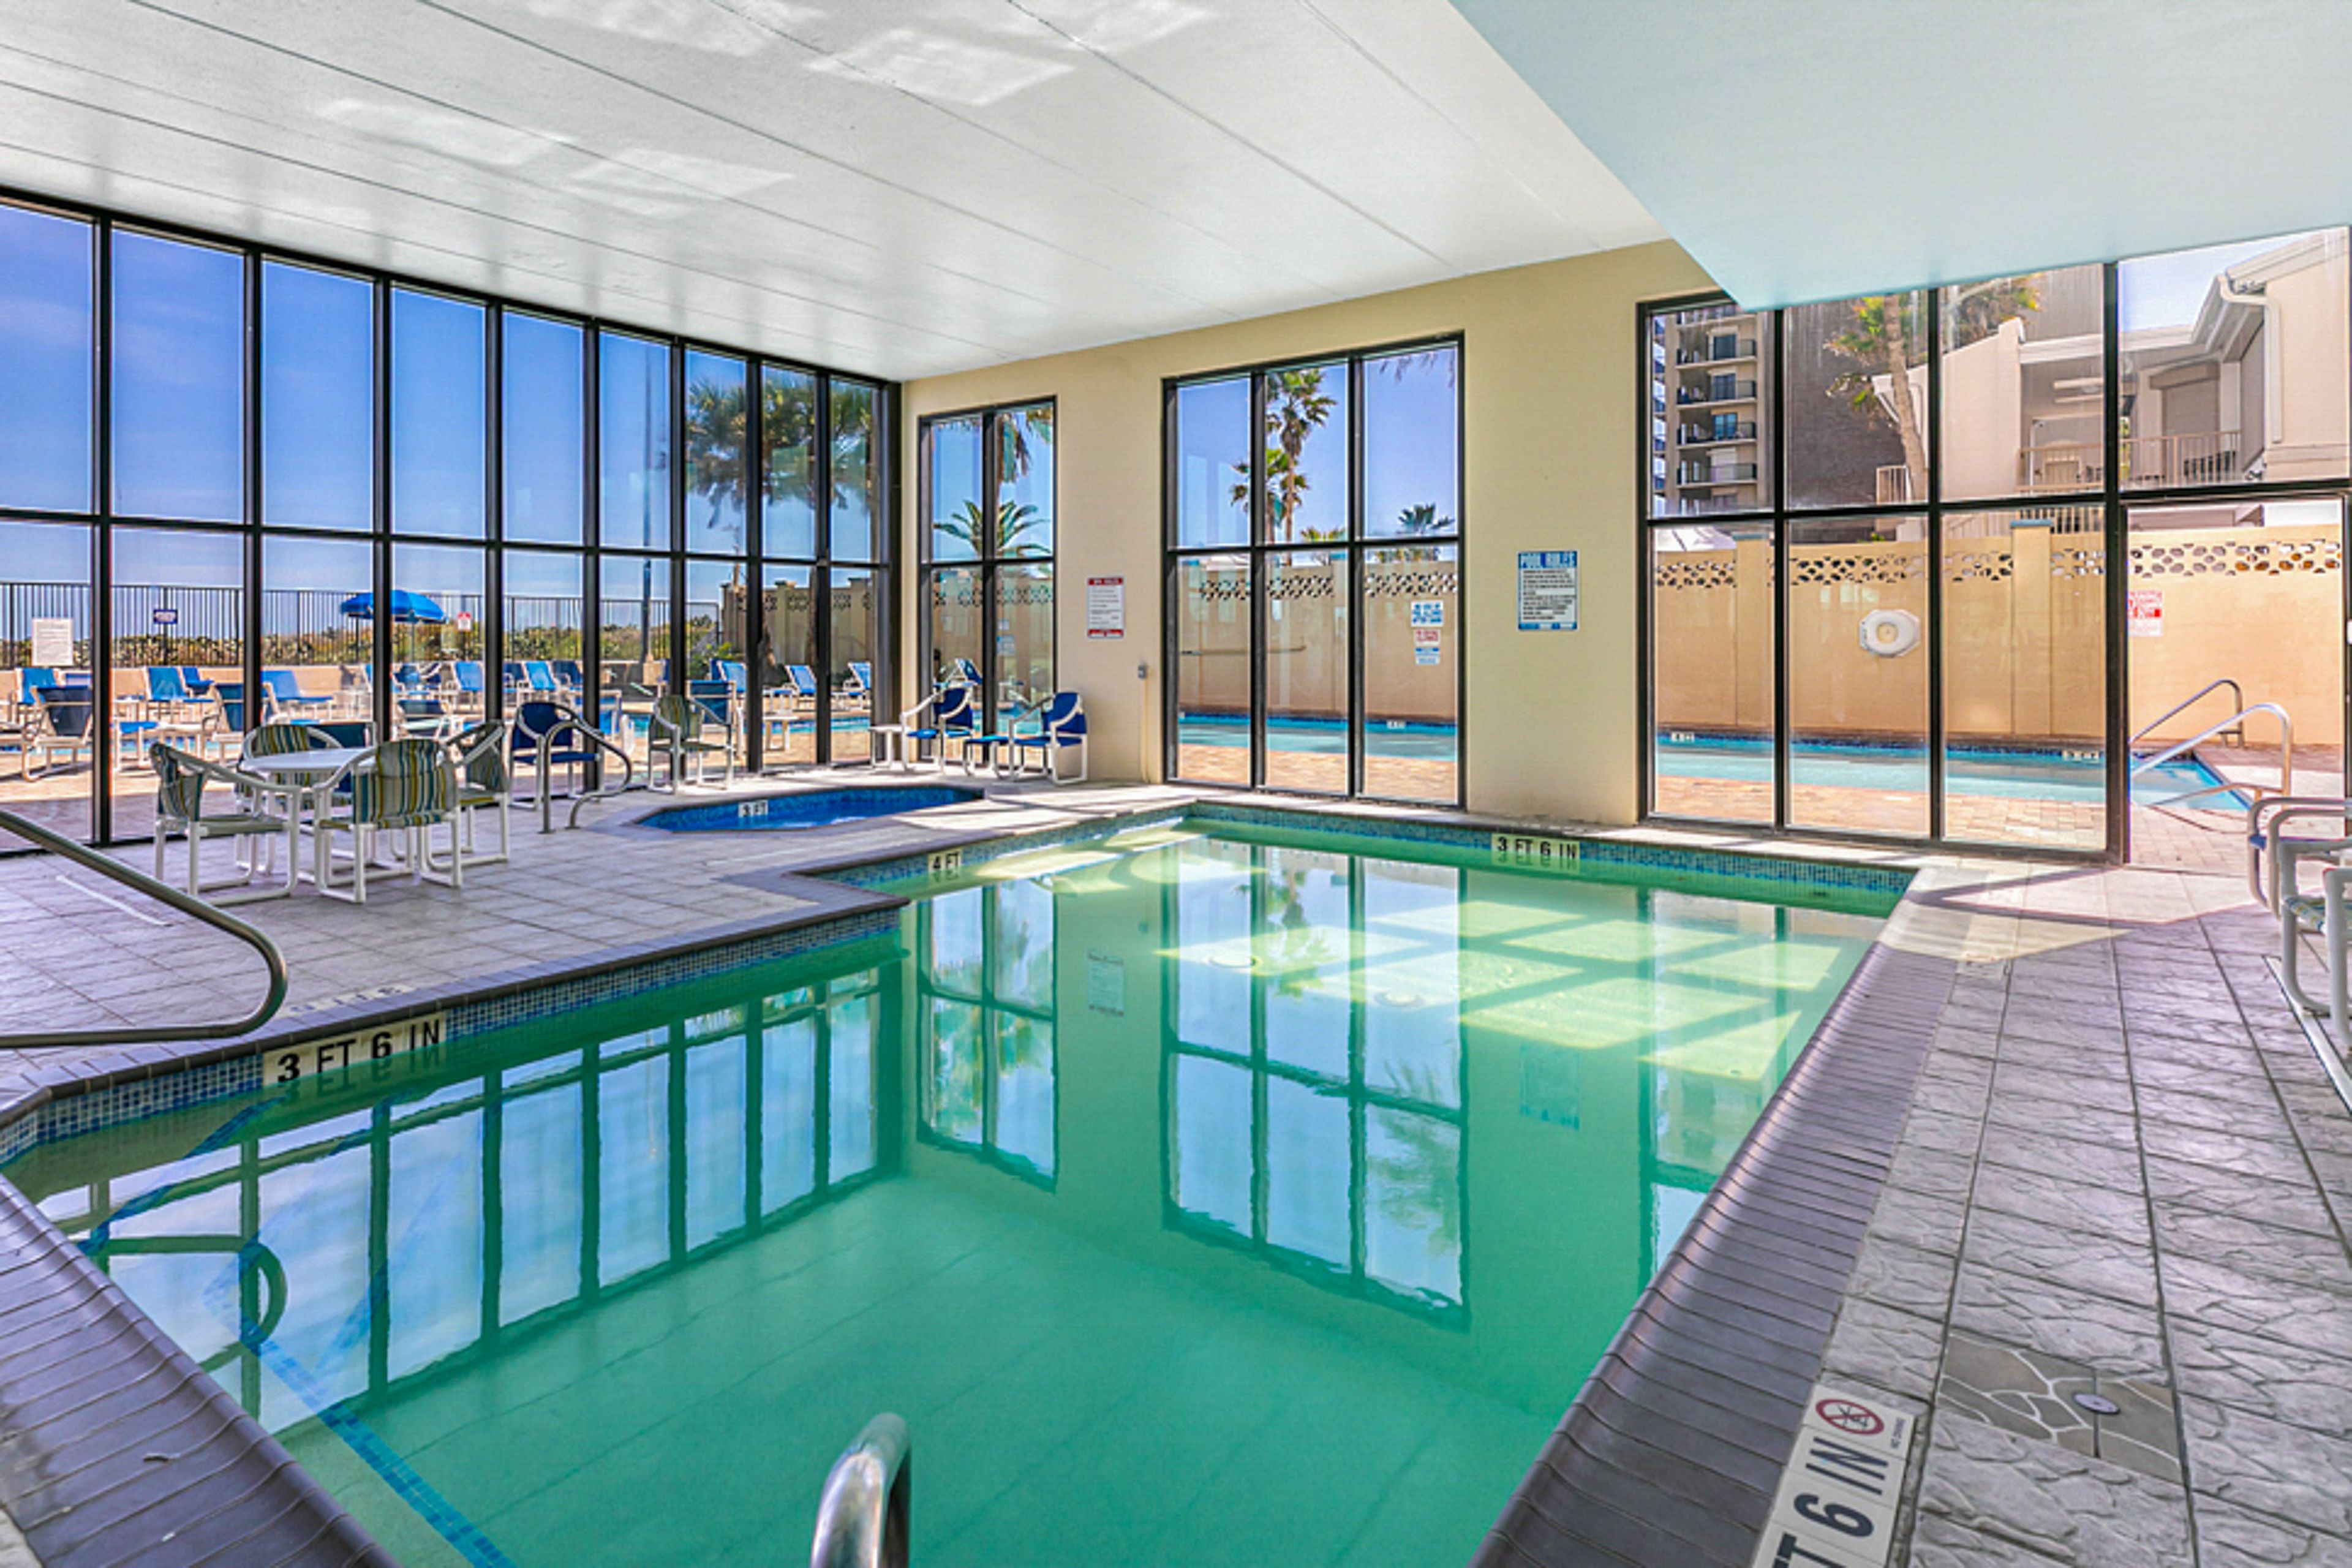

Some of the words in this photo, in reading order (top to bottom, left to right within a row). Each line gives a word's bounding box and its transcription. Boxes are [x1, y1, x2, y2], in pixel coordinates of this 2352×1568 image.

[933, 856, 941, 869] 4
[945, 851, 959, 869] FT
[1498, 836, 1508, 852] 3
[1515, 839, 1533, 854] FT
[1559, 843, 1577, 859] IN
[277, 1054, 301, 1083] 3
[317, 1038, 357, 1074] FT
[371, 1031, 393, 1060] 6
[410, 1019, 440, 1051] IN
[1806, 1437, 1888, 1495] IN
[1795, 1494, 1873, 1537] 6
